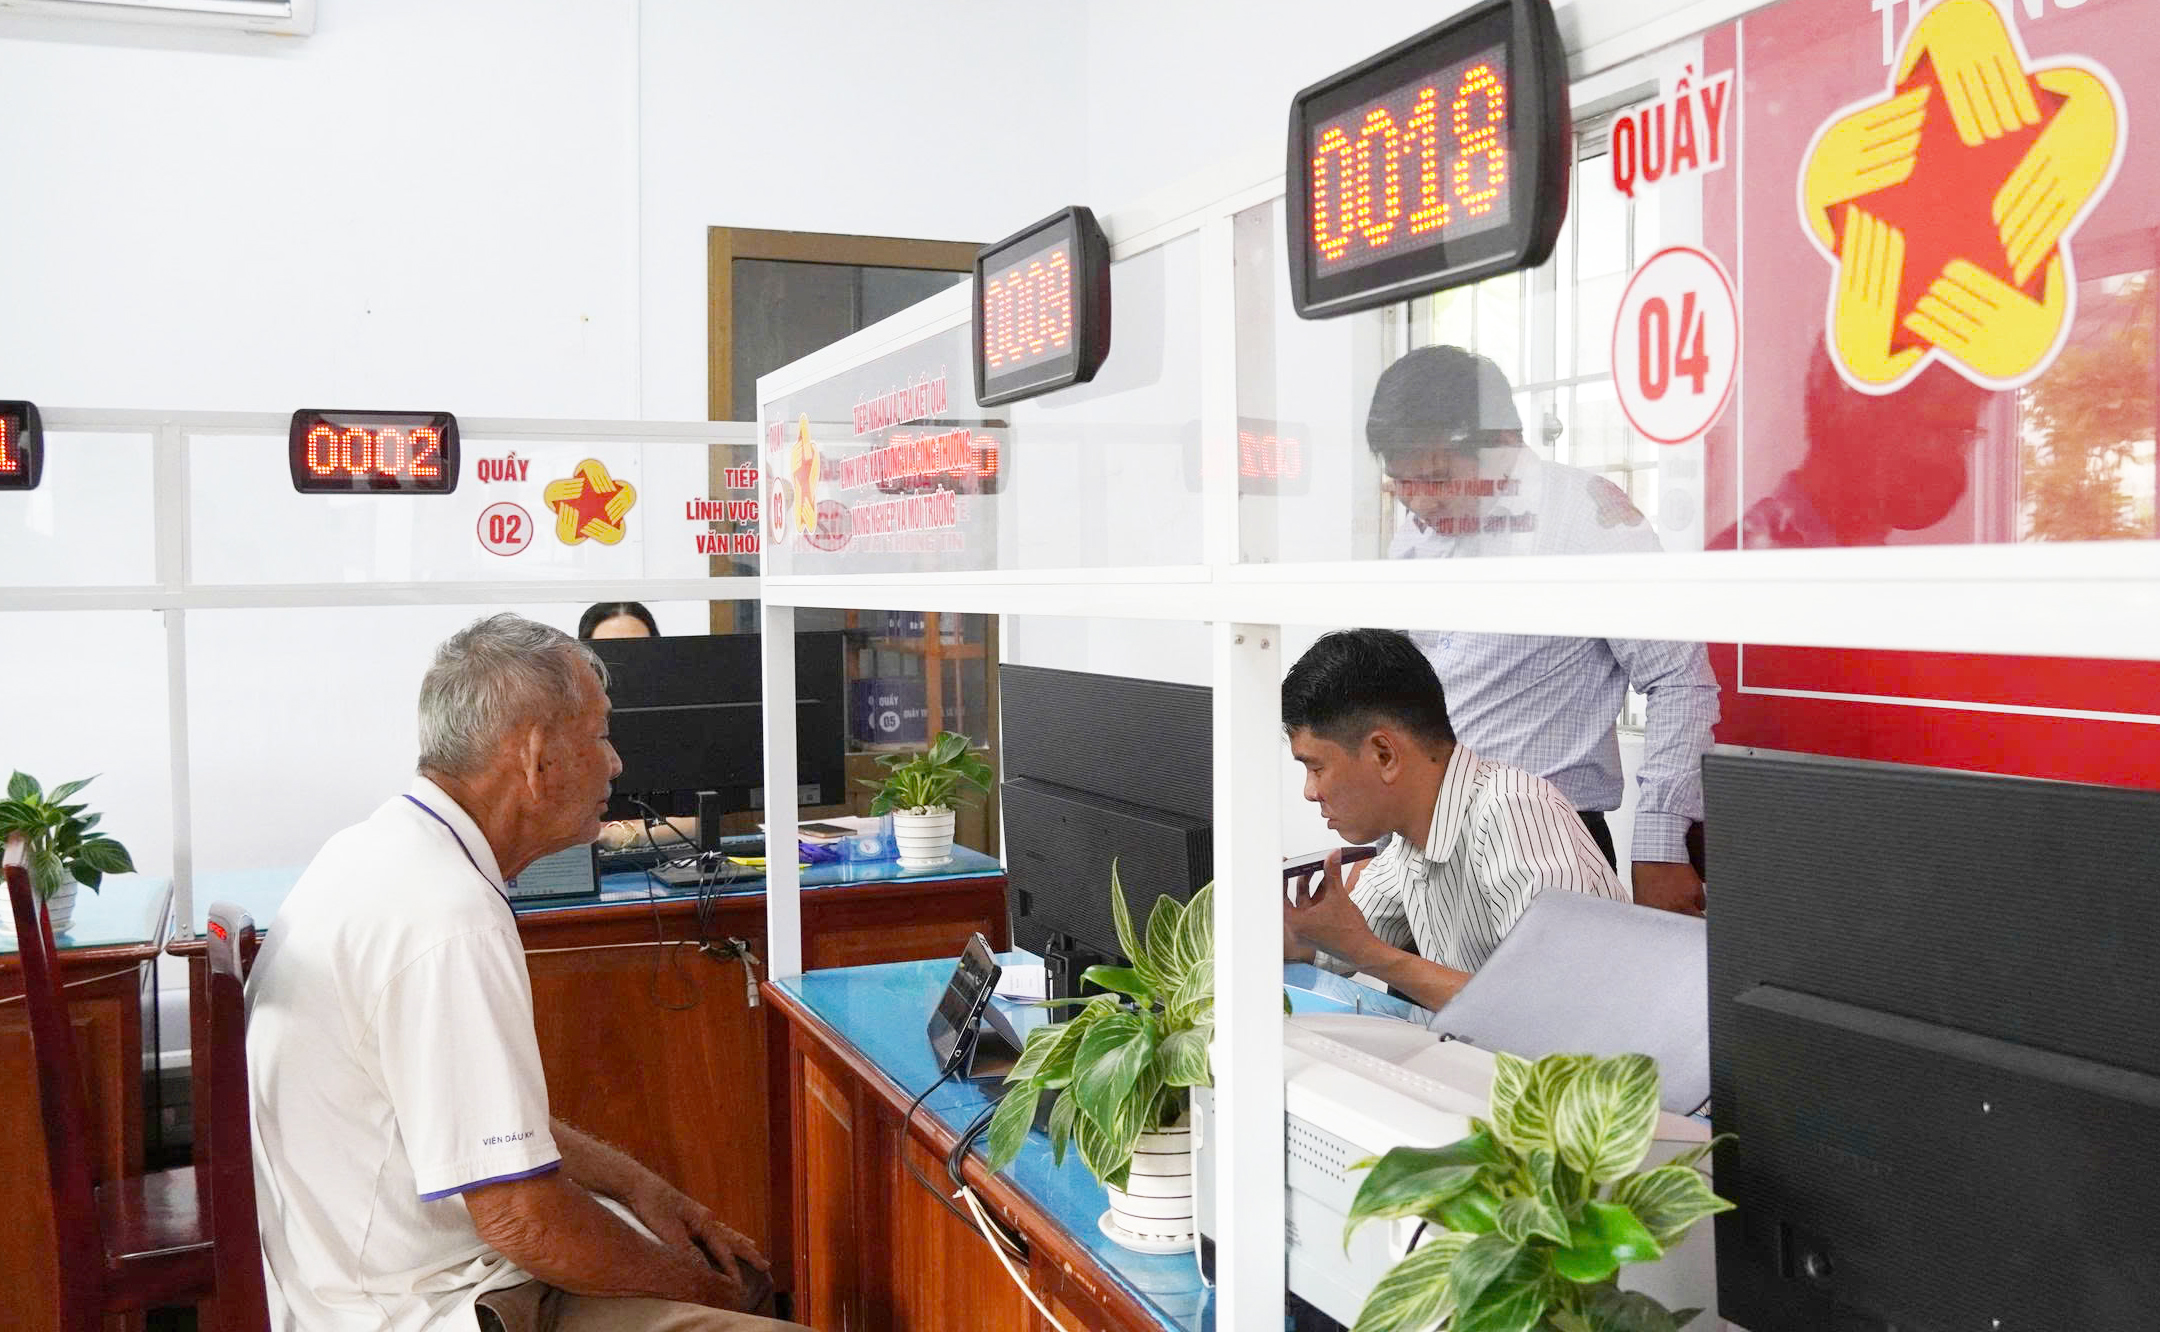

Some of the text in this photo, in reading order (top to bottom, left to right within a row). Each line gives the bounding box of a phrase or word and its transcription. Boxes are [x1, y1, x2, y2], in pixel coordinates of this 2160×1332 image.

[1612, 62, 1728, 200] QUẦY
[1312, 63, 1505, 261] 0018
[984, 250, 1071, 369] 0009
[1636, 289, 1710, 403] 04
[307, 425, 439, 476] 0002
[477, 450, 530, 484] QUẦY
[725, 462, 758, 488] TIẾP
[686, 497, 759, 525] LĨNH VỰC
[773, 492, 783, 529] 03
[488, 514, 522, 544] 02
[695, 531, 729, 554] VĂN
[883, 715, 896, 728] 05
